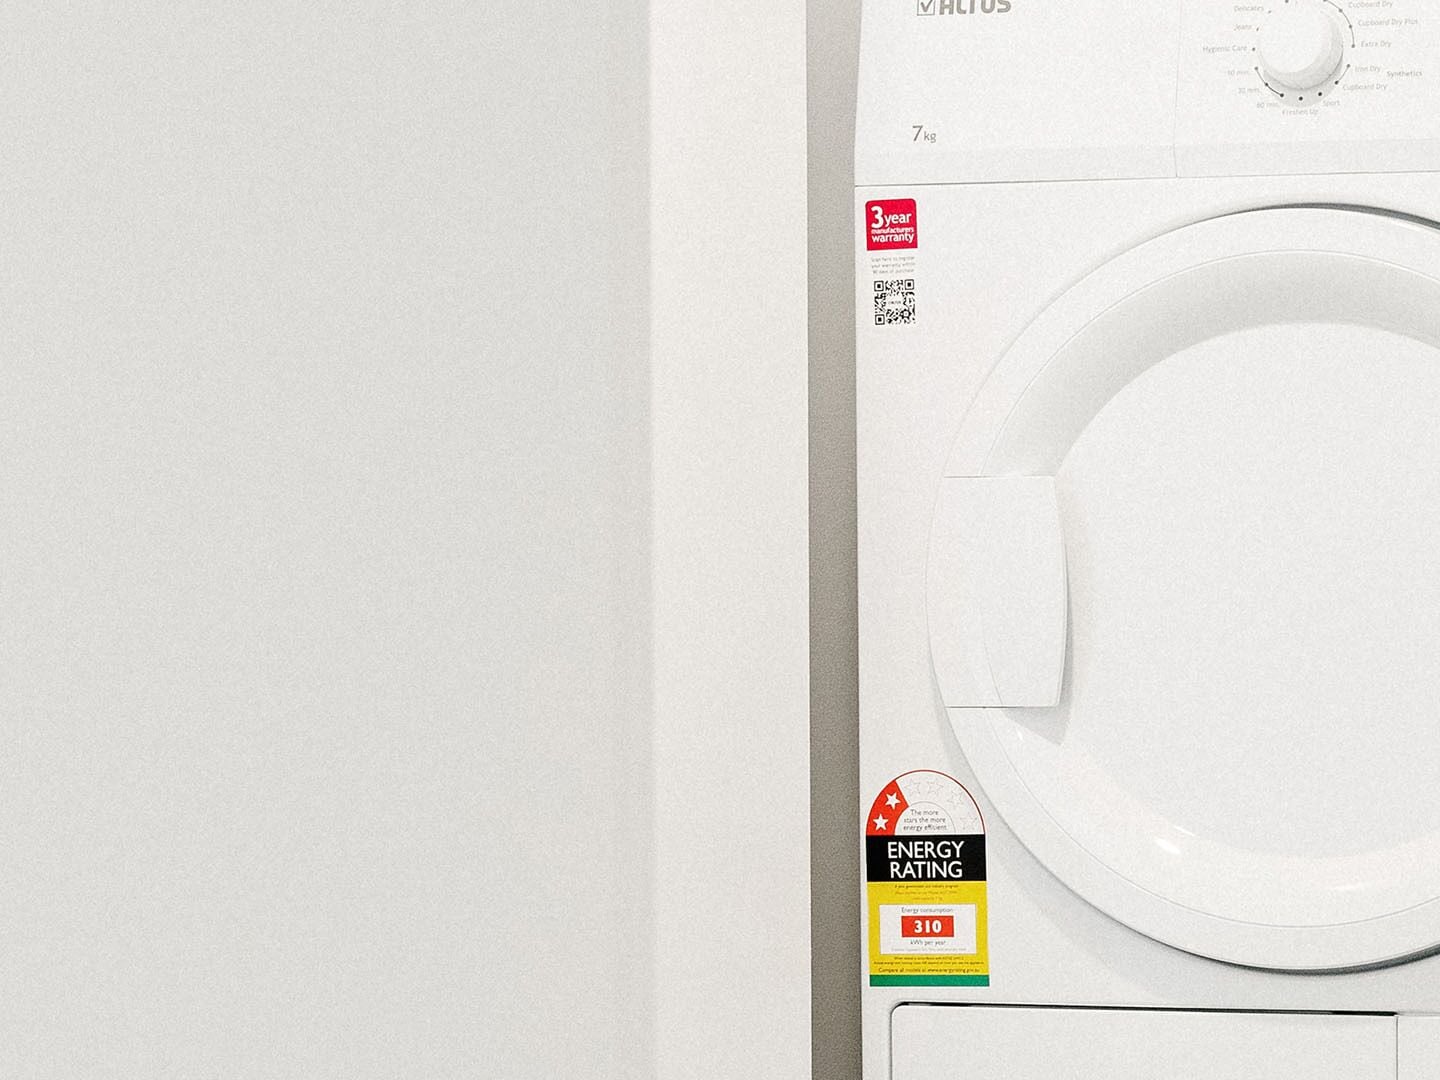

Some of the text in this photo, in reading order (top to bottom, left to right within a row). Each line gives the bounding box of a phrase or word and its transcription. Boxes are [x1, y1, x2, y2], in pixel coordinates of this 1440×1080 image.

[1380, 40, 1391, 48] Dry
[1387, 69, 1423, 78] Synthetics
[872, 233, 915, 244] warranty
[910, 808, 922, 816] The
[903, 824, 923, 832] energy
[888, 840, 965, 859] ENERGY
[890, 860, 963, 879] RATING
[901, 907, 919, 915] Energy
[913, 919, 942, 934] 310
